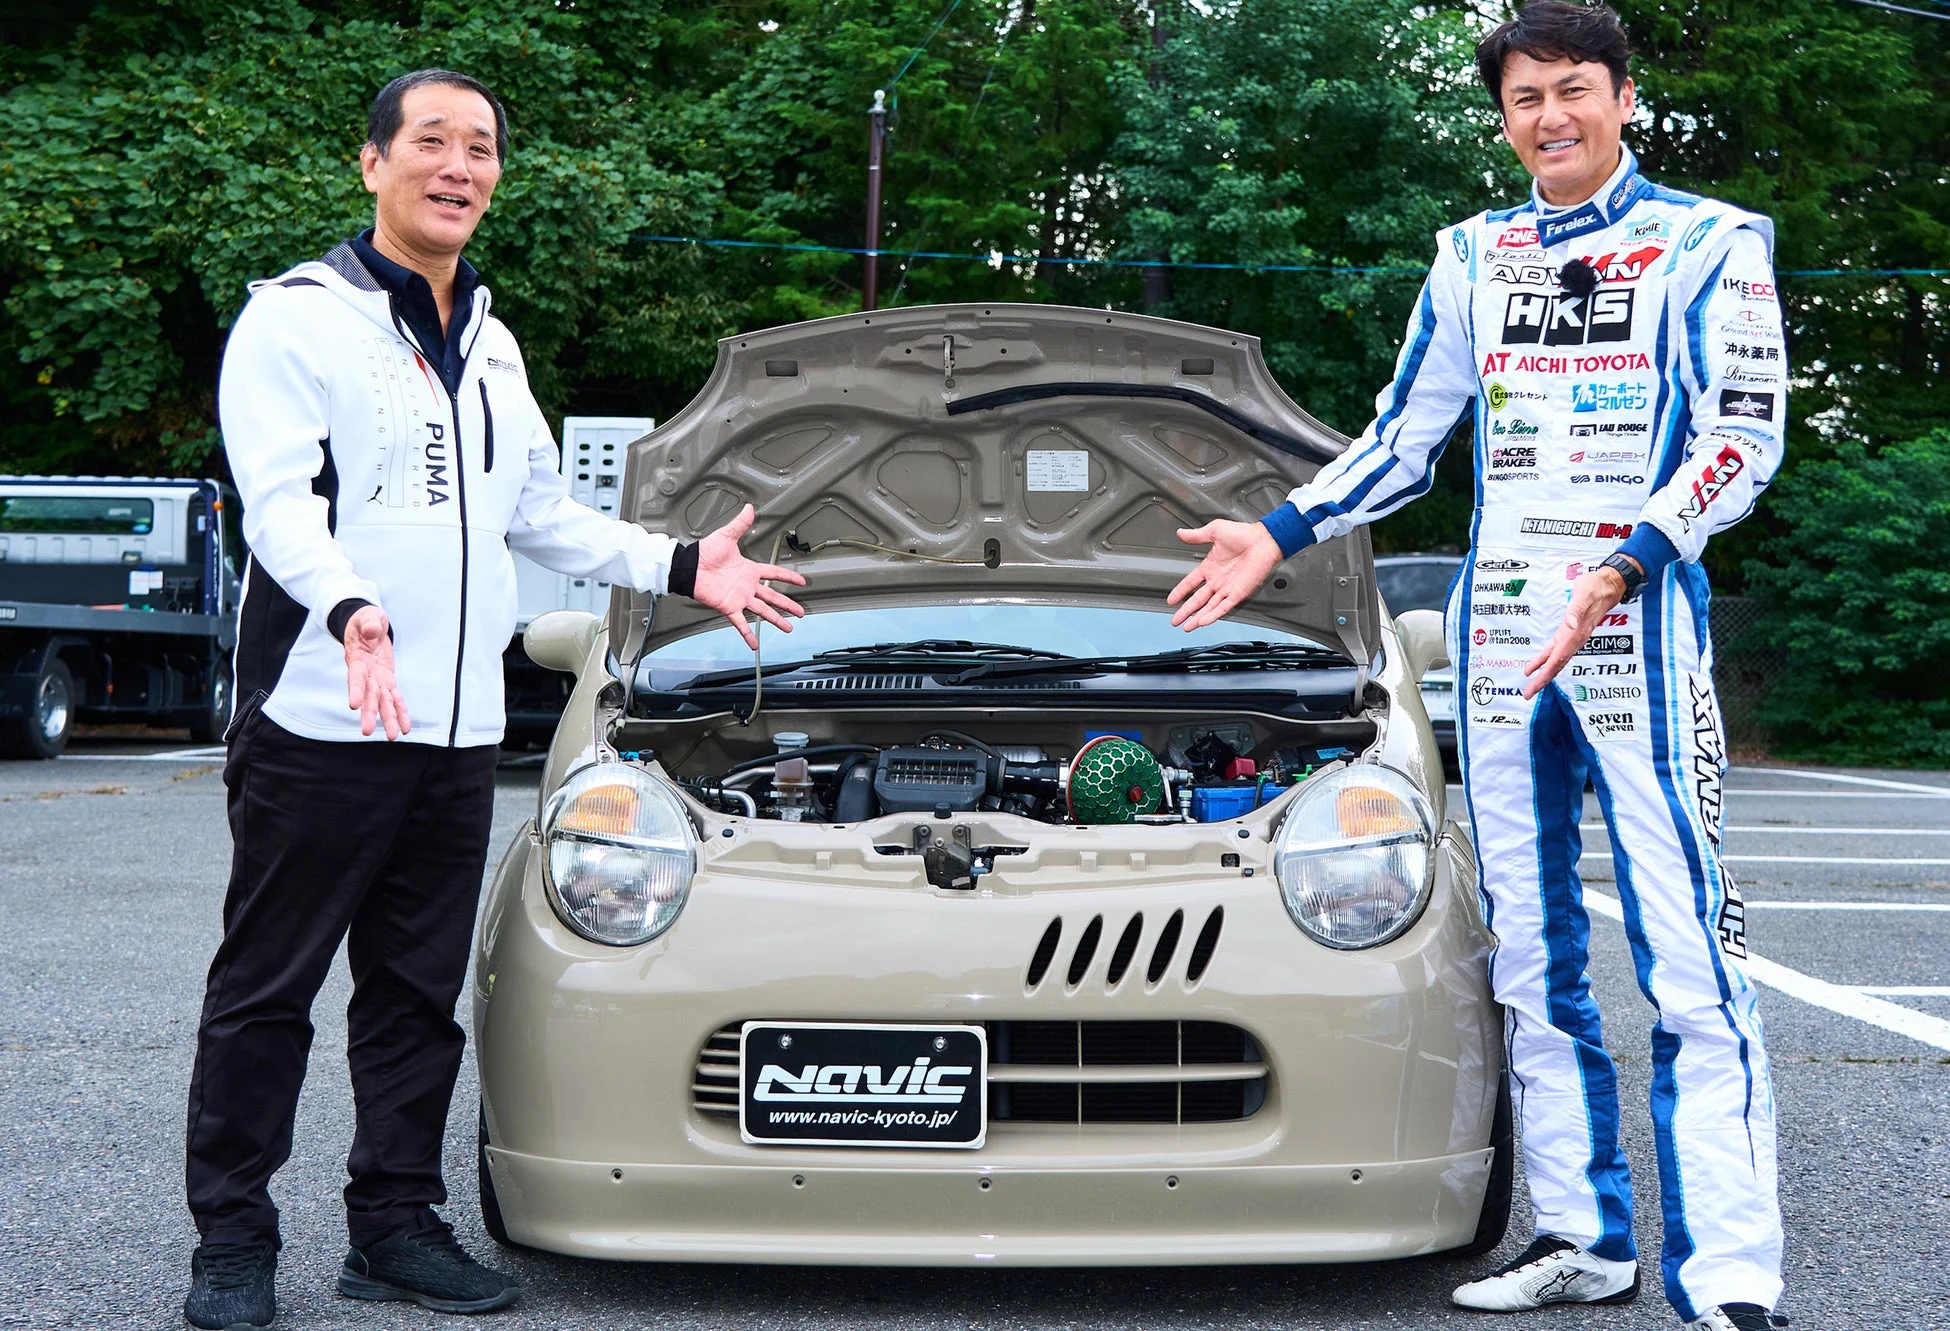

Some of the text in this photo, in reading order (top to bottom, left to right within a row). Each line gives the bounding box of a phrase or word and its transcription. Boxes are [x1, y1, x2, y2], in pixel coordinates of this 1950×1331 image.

[1501, 289, 1635, 346] HKS
[1482, 352, 1650, 377] AT AICHI TOYOTA
[1598, 396, 1647, 410] マルゼン
[1617, 423, 1648, 432] ROUGE
[1501, 447, 1538, 457] ACRE
[1587, 451, 1646, 460] JAPEX
[425, 422, 450, 507] PUMA
[1492, 458, 1538, 469] BRAKES
[1595, 475, 1645, 485] BINGO
[1474, 582, 1517, 593] OHKAWARA
[1589, 686, 1642, 700] DAISHO
[1588, 712, 1634, 726] seven
[1605, 723, 1635, 733] seven
[769, 1109, 958, 1129] www.navic-kyoto.jp/
